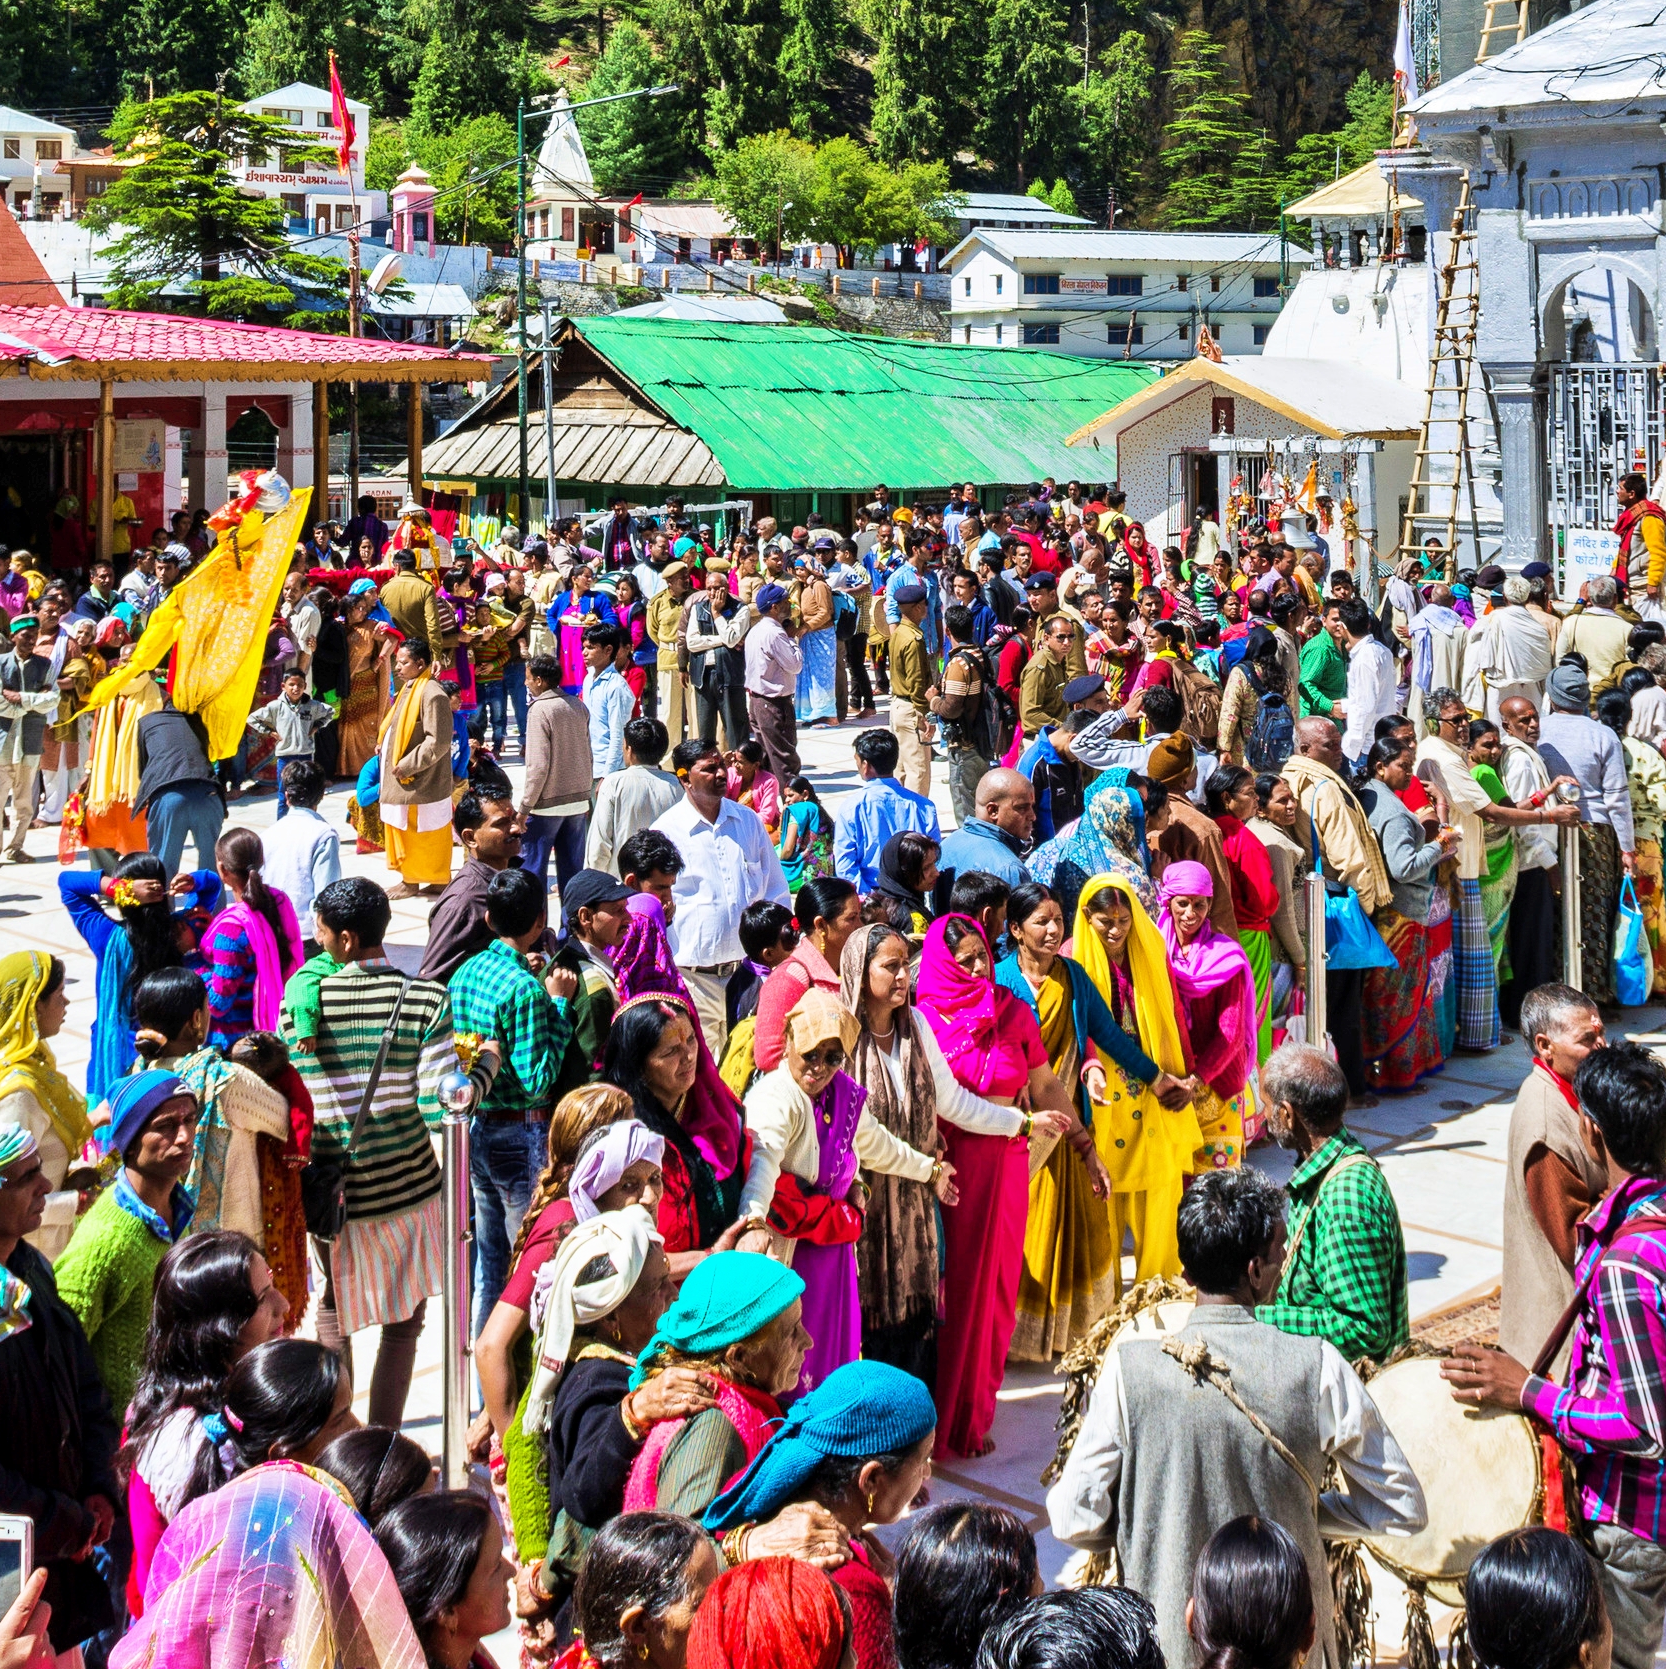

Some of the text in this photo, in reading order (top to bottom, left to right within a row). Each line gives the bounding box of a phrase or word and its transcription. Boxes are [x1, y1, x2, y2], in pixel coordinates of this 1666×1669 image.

[298, 174, 328, 185] આશ્રમ
[1573, 535, 1596, 549] मंदिर
[1600, 537, 1610, 549] के
